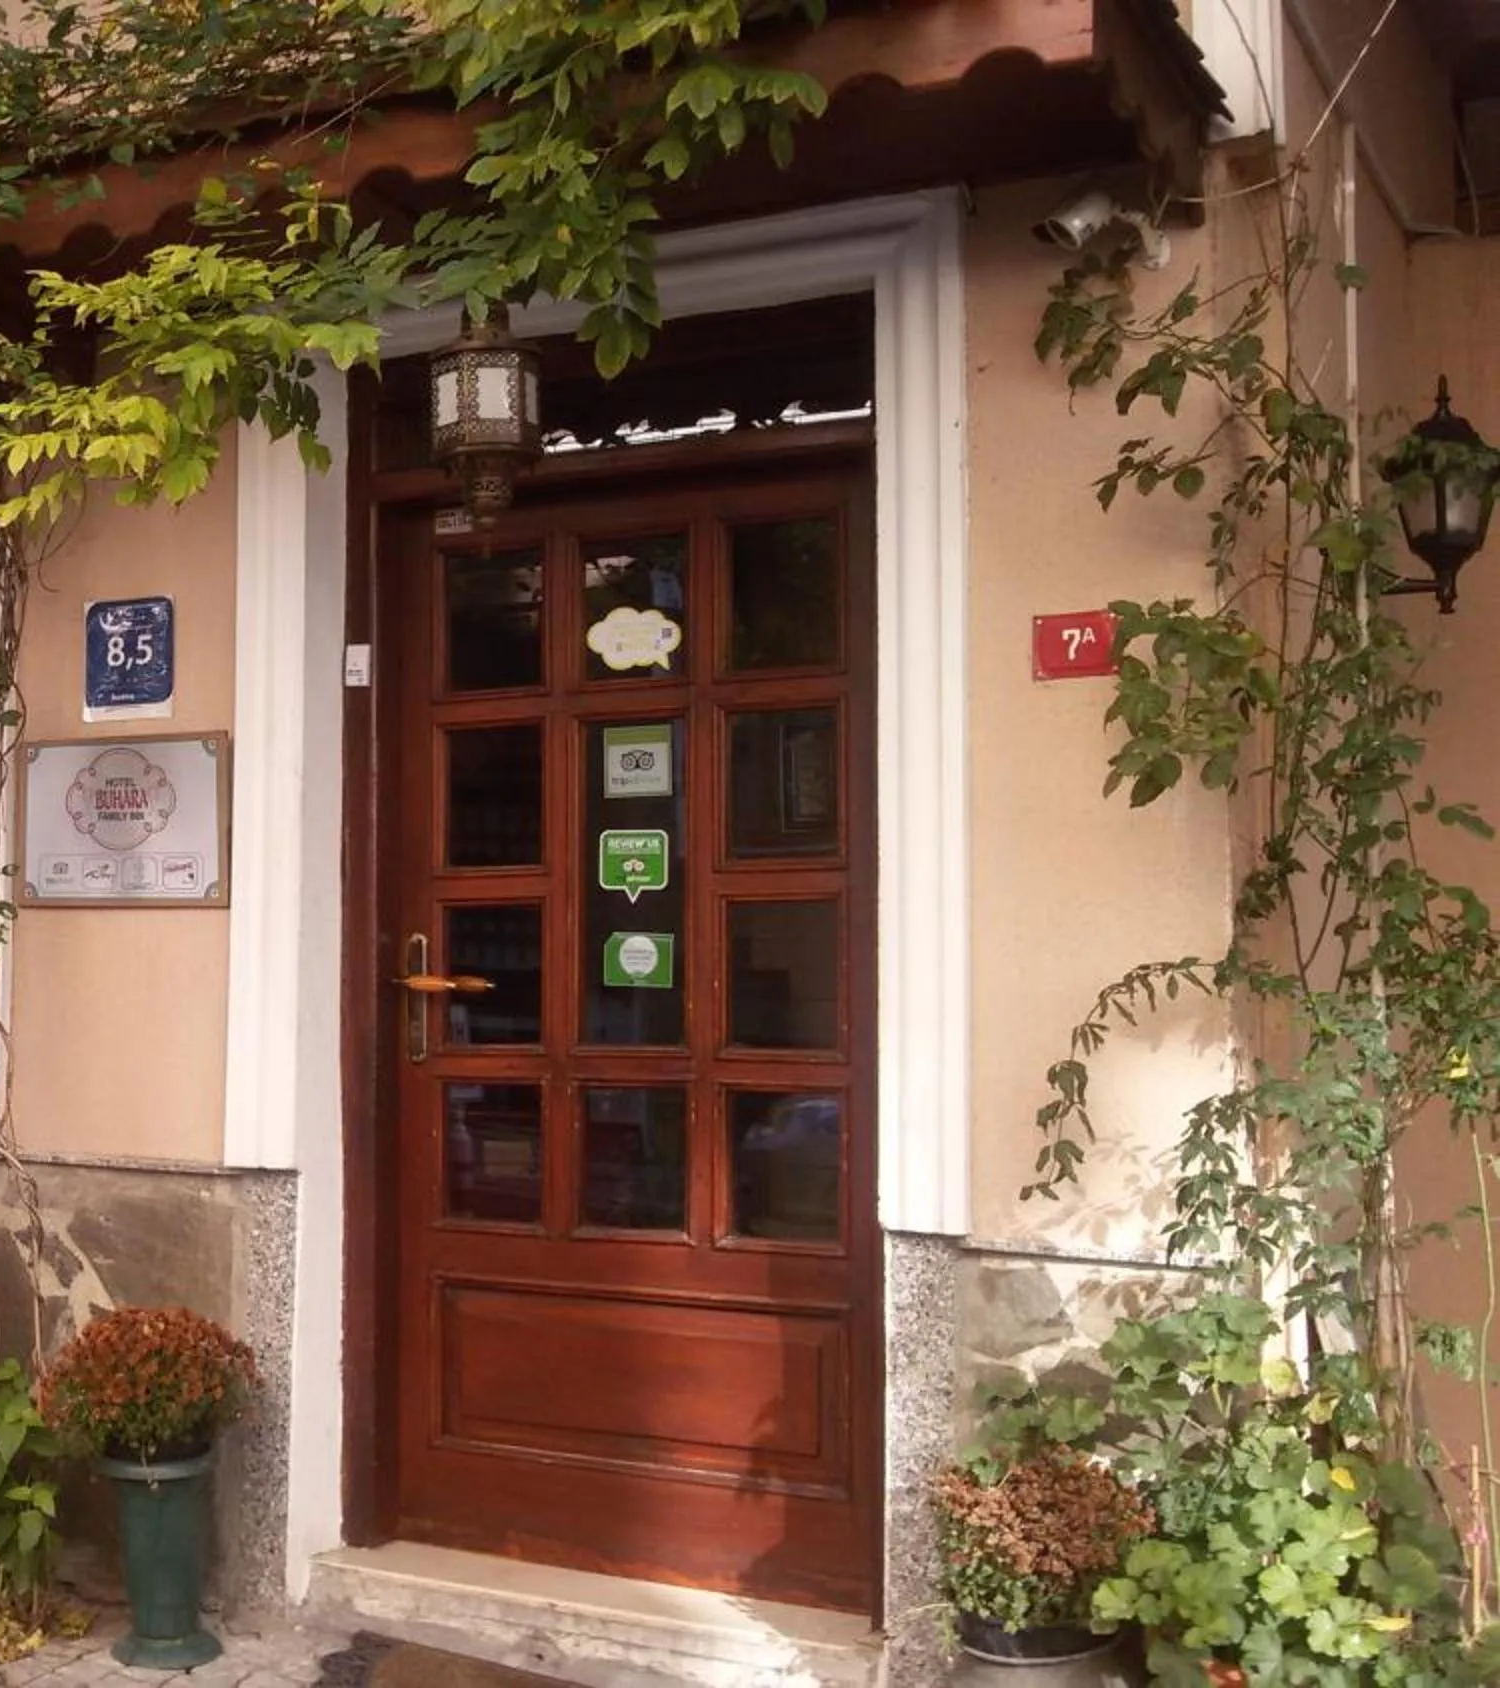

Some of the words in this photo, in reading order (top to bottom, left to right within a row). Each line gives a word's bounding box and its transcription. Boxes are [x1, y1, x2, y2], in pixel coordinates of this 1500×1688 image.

[107, 634, 153, 671] 8,5
[105, 777, 136, 788] HOTEL
[95, 789, 149, 810] BUHARA
[608, 837, 646, 849] REVIEW
